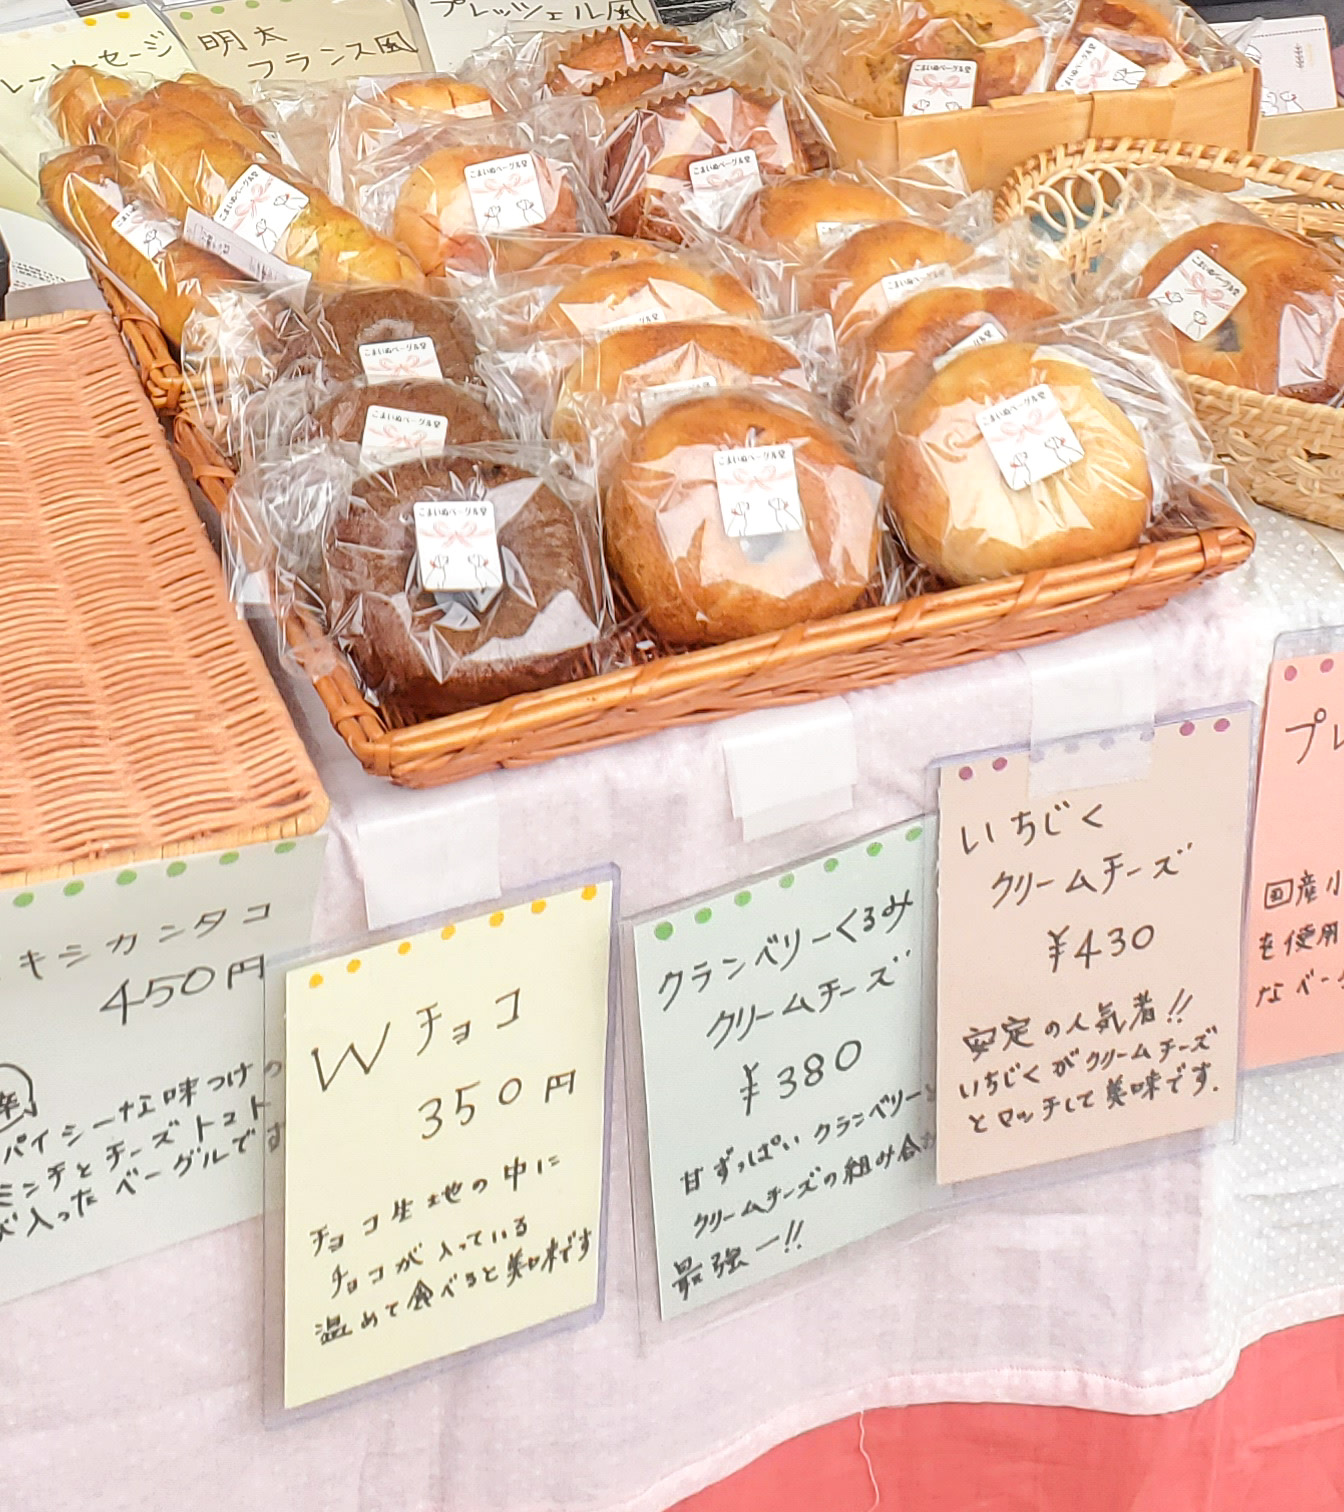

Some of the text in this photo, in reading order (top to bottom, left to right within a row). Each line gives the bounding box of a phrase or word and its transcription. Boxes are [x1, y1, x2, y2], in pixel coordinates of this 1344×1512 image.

[198, 23, 288, 57] 明太
[249, 30, 418, 80] フランス風
[960, 801, 1103, 856] いちじく
[992, 841, 1193, 909] クリームチーズ
[658, 889, 913, 1011] クランベリーくるみ
[1048, 924, 1155, 973] ¥430
[101, 954, 264, 1024] 450円
[707, 950, 911, 1049] クリームチーズ
[311, 989, 520, 1091] Wチョコ
[959, 1025, 1218, 1099] いちじくがクリームチーズ
[418, 1070, 575, 1139] 350円
[739, 1040, 862, 1116] ¥380
[310, 1155, 560, 1256] チョコ生地の中に
[331, 1215, 527, 1299] チョコが入っている
